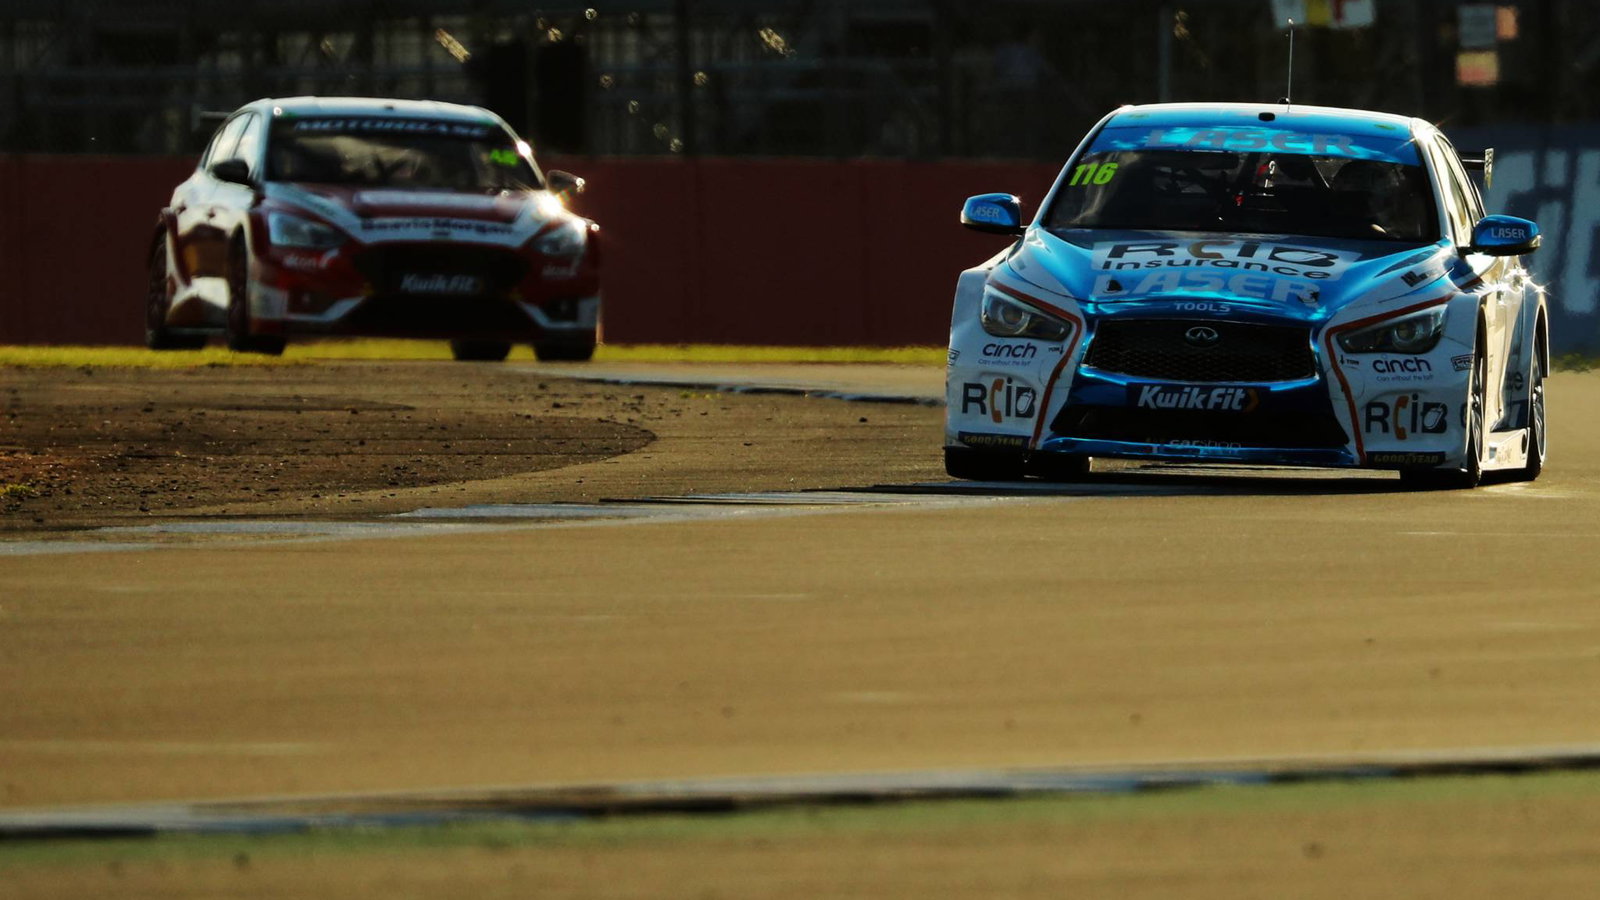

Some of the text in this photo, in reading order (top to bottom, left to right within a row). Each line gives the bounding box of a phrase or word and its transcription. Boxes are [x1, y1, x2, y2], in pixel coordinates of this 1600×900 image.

[1144, 127, 1358, 156] LASER
[1069, 162, 1118, 186] 116
[969, 205, 1001, 219] LASER
[1490, 226, 1526, 240] LASER
[1090, 271, 1323, 308] LASER
[1174, 302, 1231, 313] TOOLS
[982, 342, 1037, 359] cinch
[1372, 356, 1432, 374] cinch
